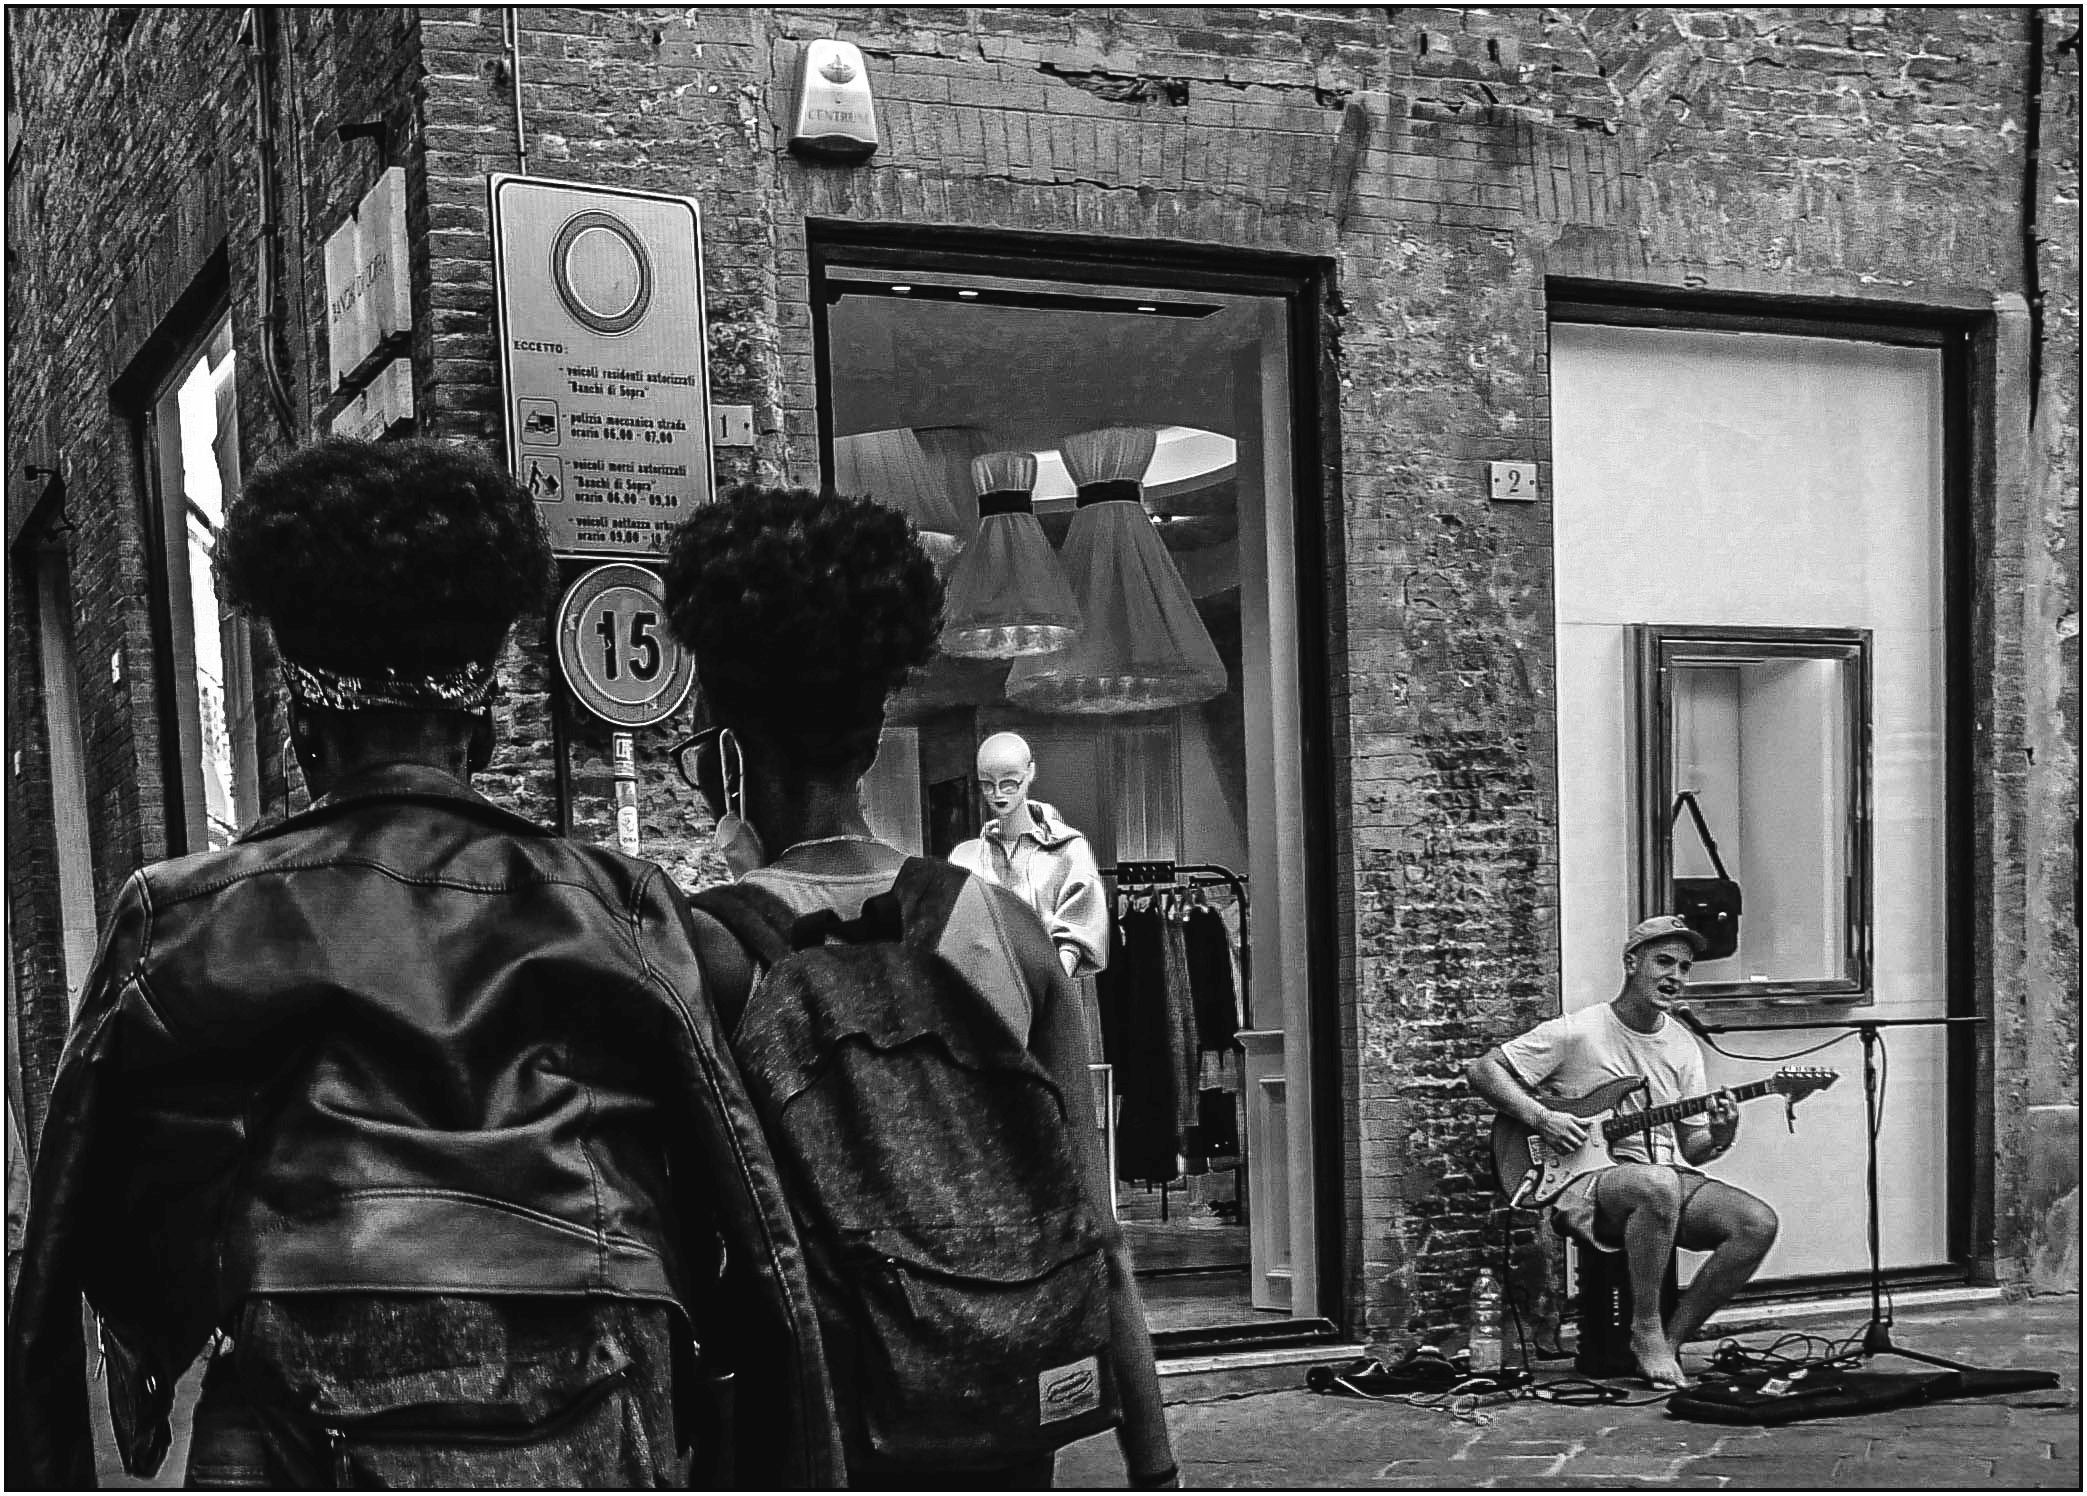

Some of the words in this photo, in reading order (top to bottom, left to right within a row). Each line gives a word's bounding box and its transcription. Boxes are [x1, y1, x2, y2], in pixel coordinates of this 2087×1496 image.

[513, 340, 569, 354] ECCETTO:
[567, 365, 598, 378] veicoli
[602, 369, 643, 382] residenti
[647, 372, 696, 386] autorizzati
[608, 384, 616, 395] di
[657, 418, 687, 431] strada
[719, 413, 729, 439] 1
[571, 427, 599, 438] orario
[603, 427, 634, 441] 06.00
[645, 430, 674, 444] 07.00
[573, 459, 605, 471] veicoli
[608, 461, 635, 473] merci
[638, 463, 687, 477] autorizzati
[614, 478, 623, 489] di
[1508, 469, 1521, 493] 2
[575, 491, 604, 502] orario
[576, 516, 608, 528] veicoli
[577, 530, 606, 541] orario
[596, 610, 661, 682] 15
